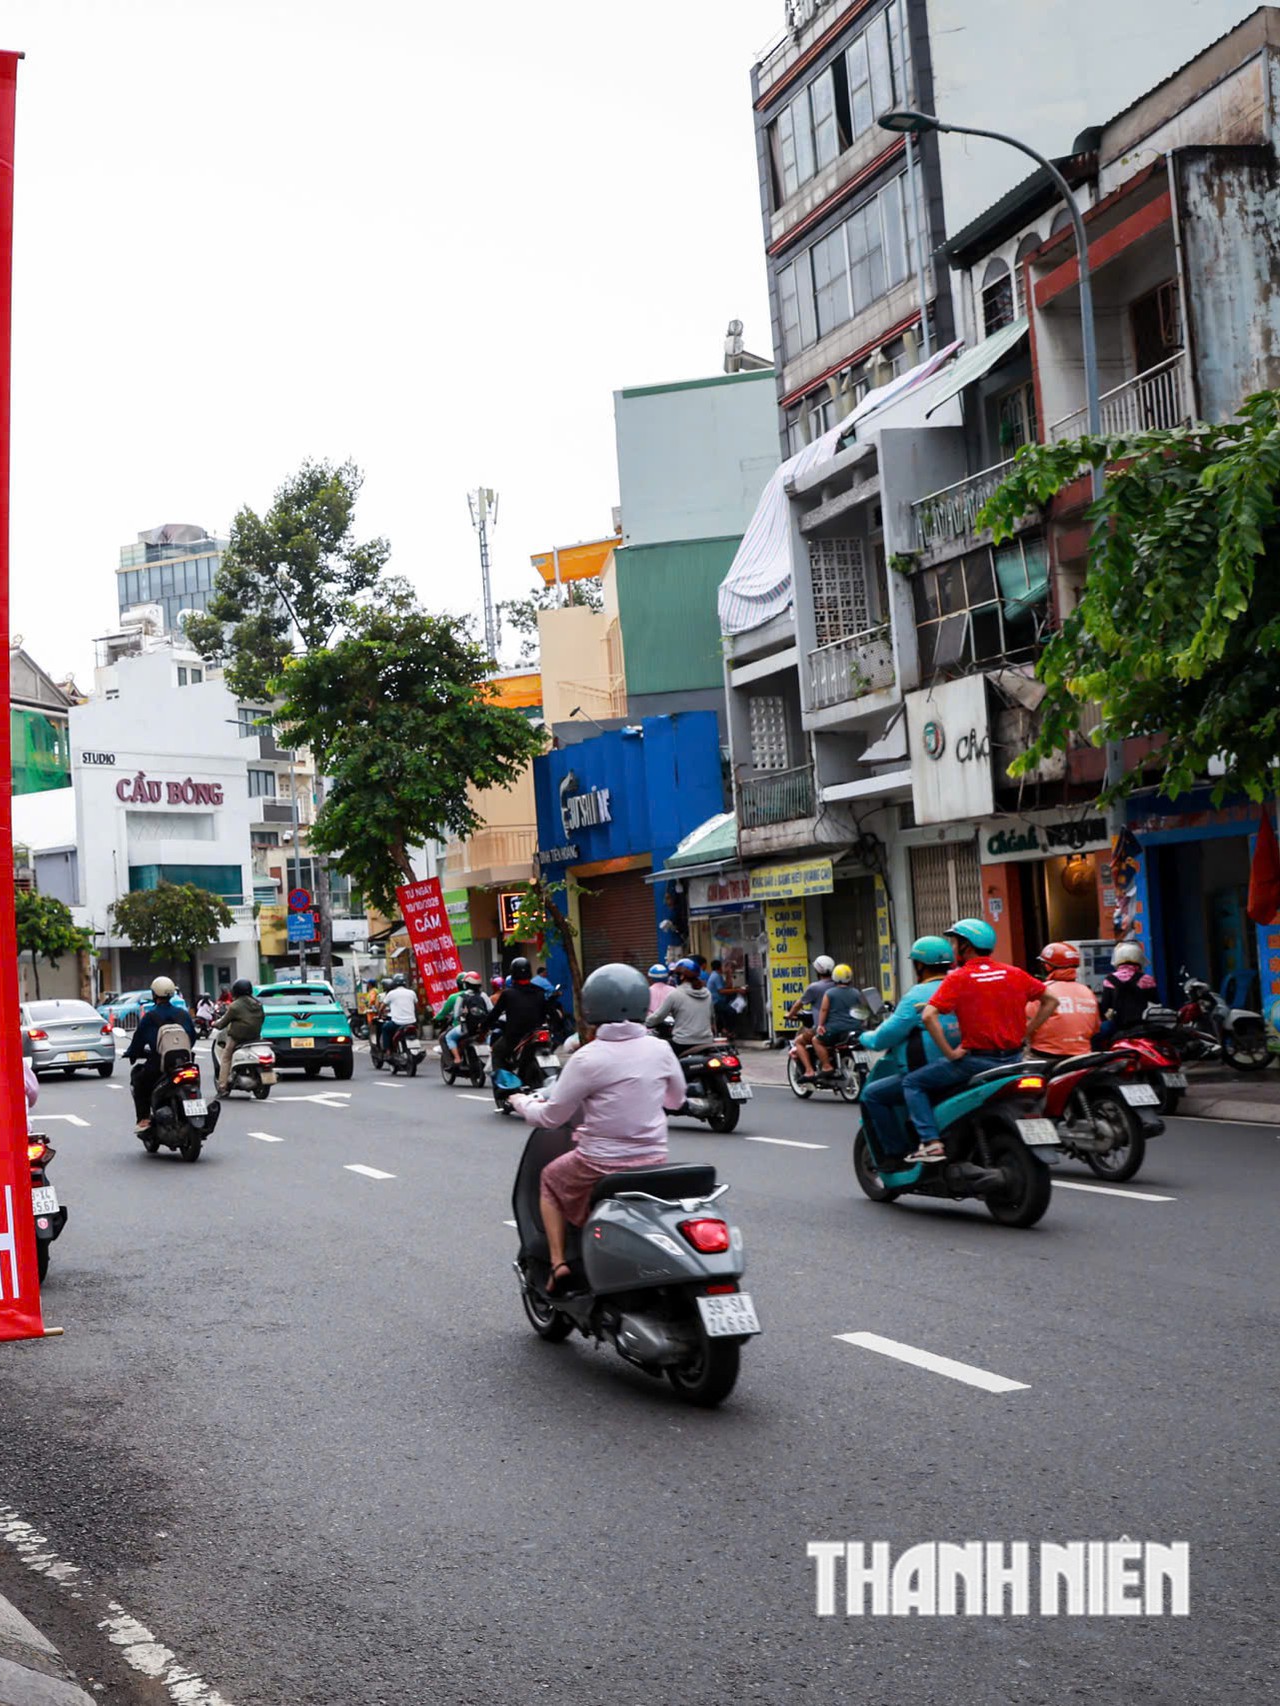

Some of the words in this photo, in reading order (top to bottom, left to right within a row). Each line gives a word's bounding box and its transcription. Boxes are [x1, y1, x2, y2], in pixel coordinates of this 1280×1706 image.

[82, 752, 116, 765] STUDIO
[116, 770, 162, 804] CẦU
[166, 776, 224, 806] BÓNG
[415, 911, 442, 933] CẤM
[782, 982, 804, 994] MICA
